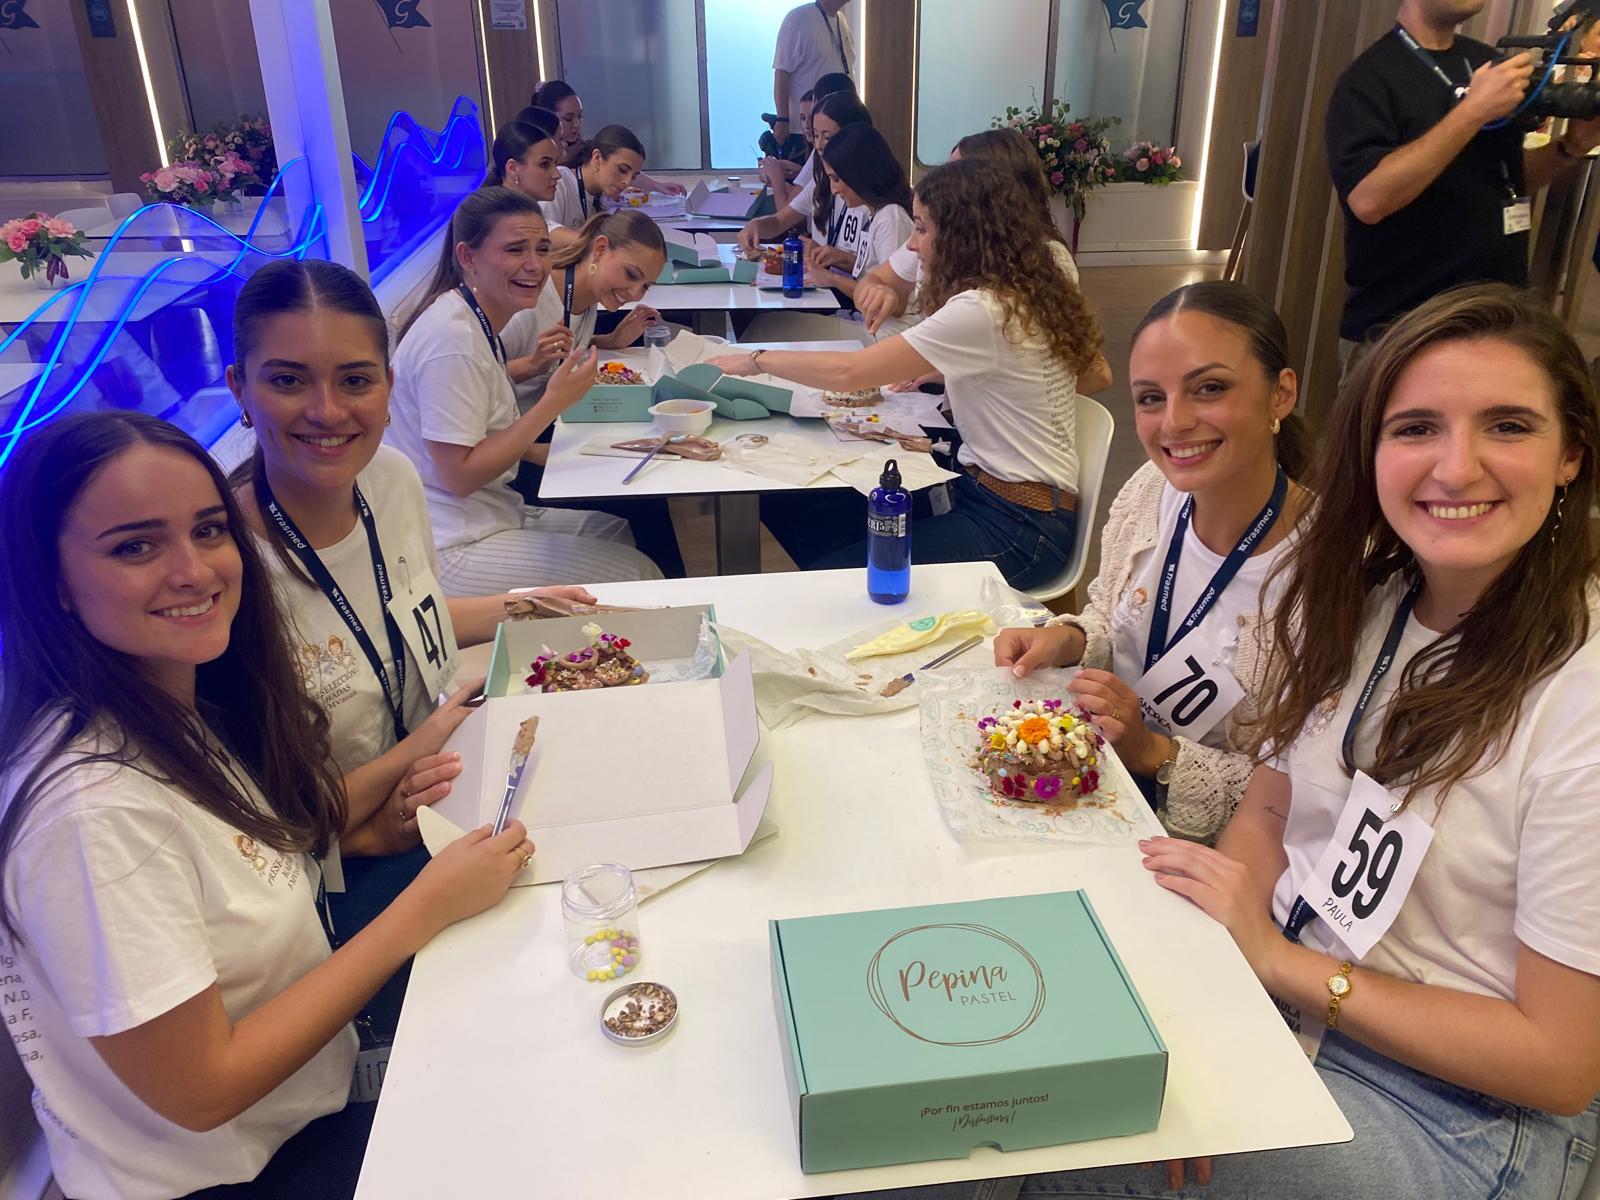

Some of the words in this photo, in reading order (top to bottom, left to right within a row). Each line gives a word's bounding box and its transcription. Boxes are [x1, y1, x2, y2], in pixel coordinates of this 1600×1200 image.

[844, 214, 858, 243] 69
[273, 510, 307, 550] Trasmed
[1244, 508, 1274, 549] Trasmed
[376, 563, 391, 606] Trasmed
[1160, 571, 1175, 612] Trasmed
[337, 594, 362, 632] Trasmed
[1190, 586, 1216, 625] Trasmed
[412, 594, 448, 670] 47
[1152, 655, 1218, 727] 70
[1139, 697, 1172, 732] ANDREA
[1330, 808, 1403, 920] 59
[1322, 897, 1353, 932] PAULA
[899, 960, 1008, 1002] Pepina
[960, 991, 1016, 1007] PASTEL
[946, 1104, 960, 1113] fin
[963, 1098, 1010, 1111] estamos
[1011, 1093, 1049, 1109] juntos!
